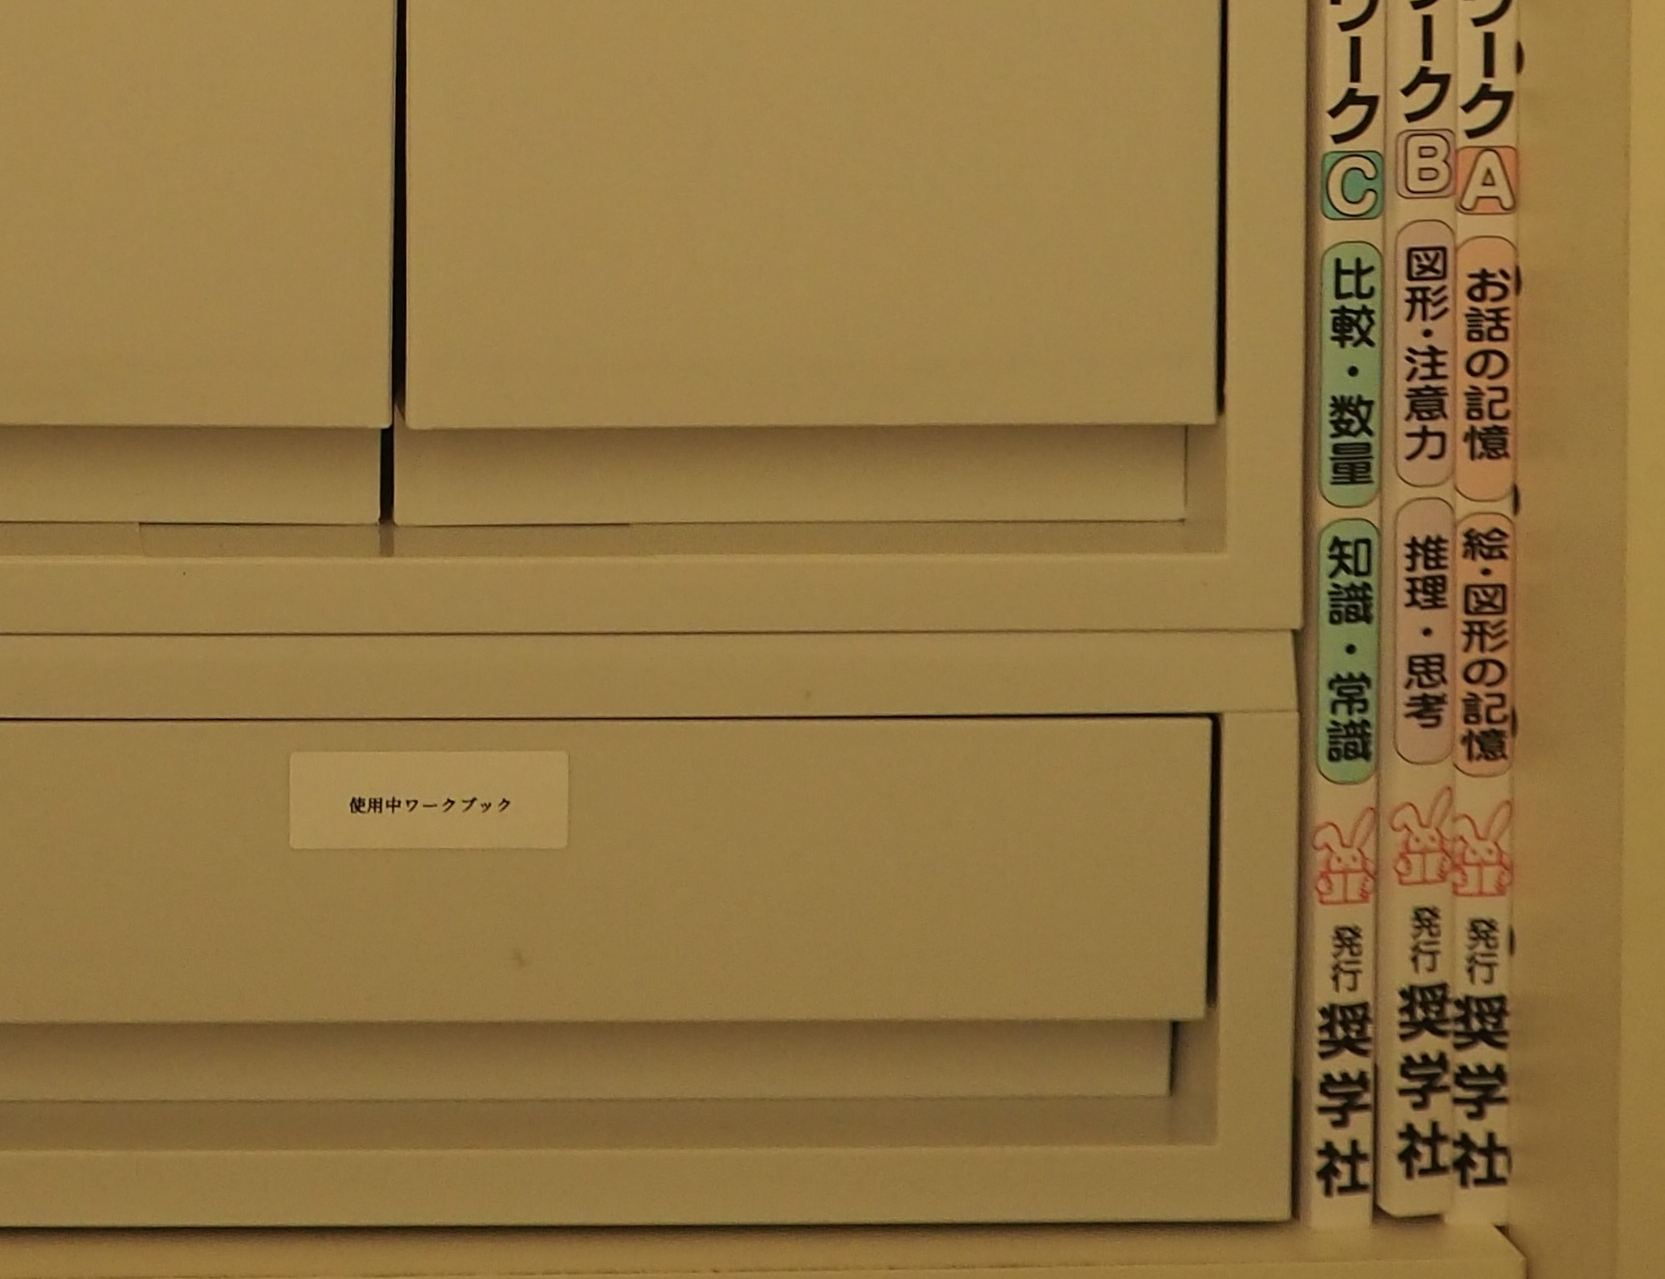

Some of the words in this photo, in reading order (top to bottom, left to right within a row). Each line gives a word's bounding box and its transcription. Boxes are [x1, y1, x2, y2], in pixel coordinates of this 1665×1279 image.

[1327, 154, 1378, 217] C
[1405, 133, 1452, 194] B
[1459, 148, 1515, 211] A
[1329, 257, 1376, 486] 比較・数量
[1404, 246, 1449, 461] 図形・注意力
[1464, 268, 1510, 462] お話の記憶
[1326, 535, 1374, 763] 知識・常識
[1404, 534, 1449, 729] 推理・思考
[1460, 527, 1509, 763] 絵・図形の記憶
[348, 796, 511, 815] 使用中ワークブック
[1331, 925, 1363, 992] 発行
[1410, 905, 1441, 974] 発行
[1466, 918, 1499, 985] 発行
[1316, 1001, 1373, 1198] 奨学社
[1397, 982, 1451, 1180] 奨学社
[1452, 995, 1509, 1189] 奨学社
